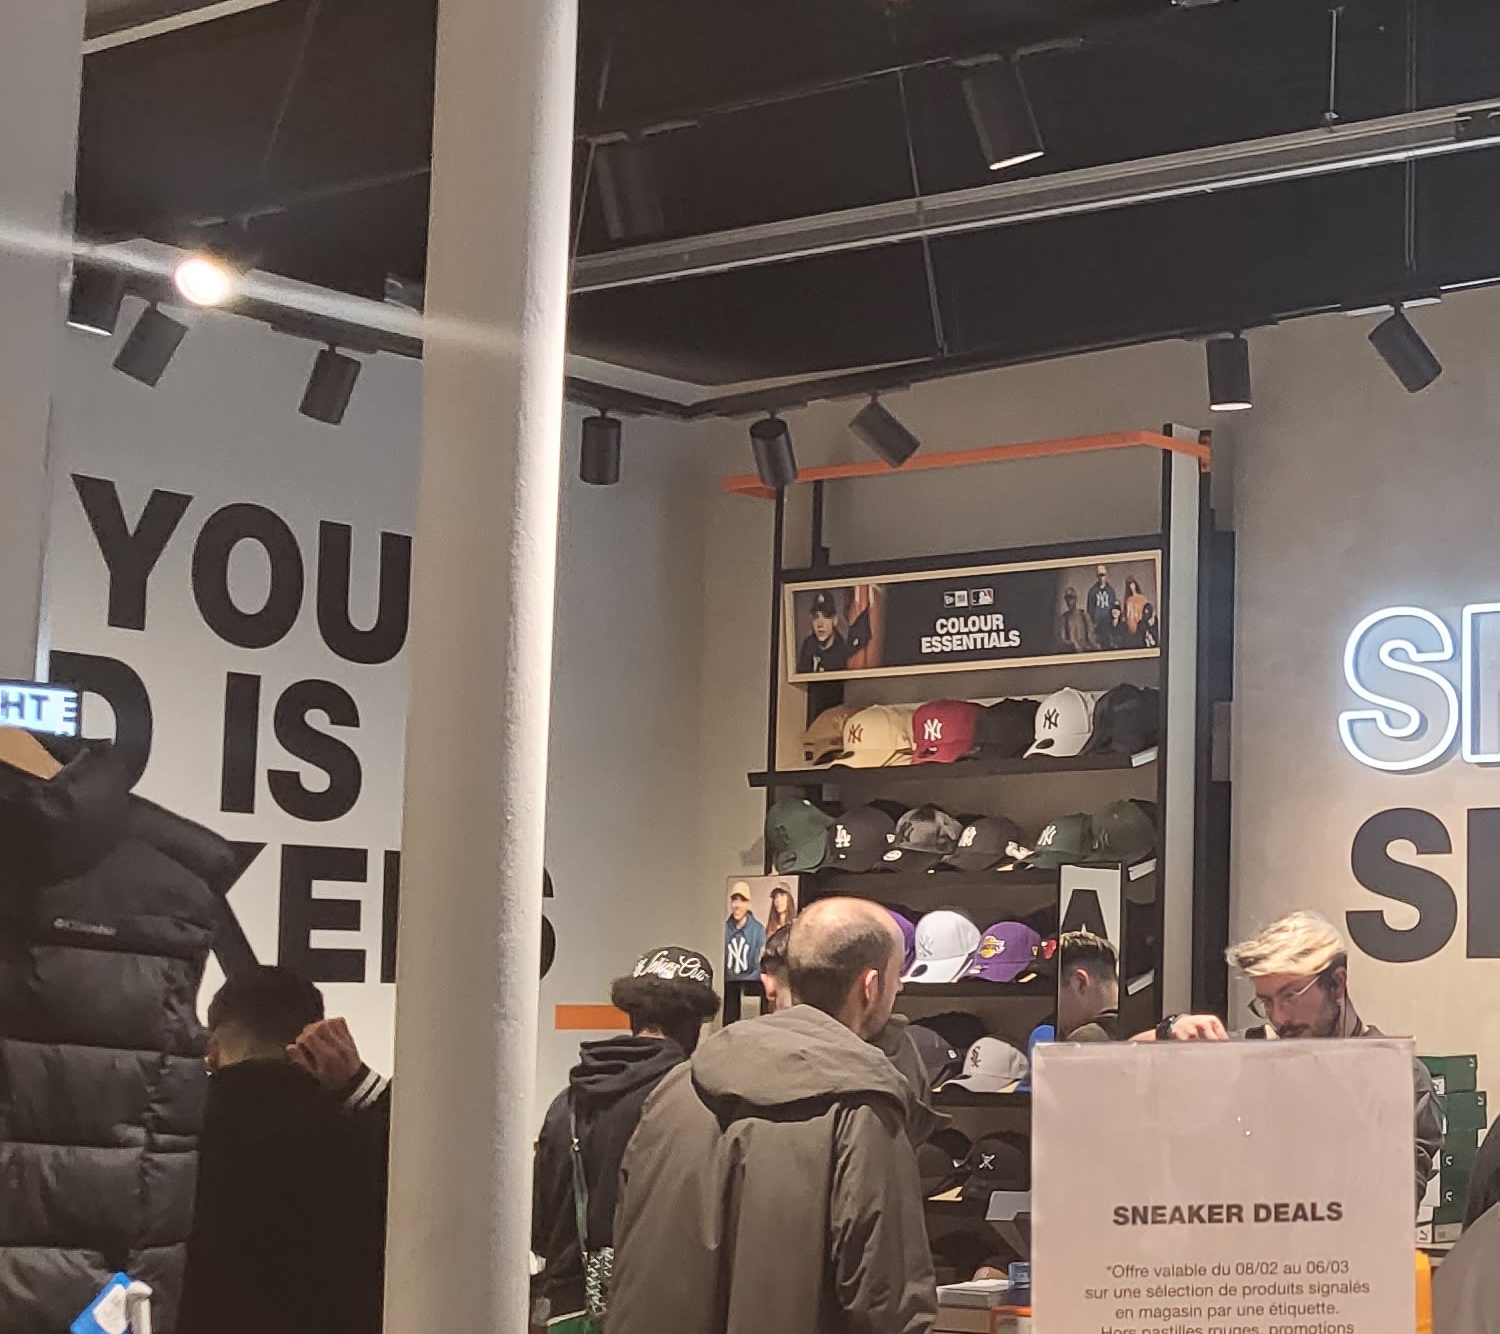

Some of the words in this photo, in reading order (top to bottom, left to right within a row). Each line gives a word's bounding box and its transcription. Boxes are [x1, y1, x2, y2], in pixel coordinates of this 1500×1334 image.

[71, 472, 413, 665] YOU
[935, 614, 1004, 635] COLOUR
[921, 630, 1021, 654] ESSENTIALS
[923, 718, 943, 742] NY
[220, 670, 363, 823] IS
[727, 936, 750, 974] NY
[1113, 1203, 1244, 1225] SNEAKER
[1253, 1201, 1343, 1223] DEALS
[1153, 1262, 1207, 1278] valable
[1211, 1261, 1231, 1276] du
[1235, 1261, 1278, 1276] 08/02
[1283, 1264, 1301, 1275] au
[1306, 1259, 1349, 1275] 06/03
[1085, 1287, 1109, 1300] sur
[1114, 1287, 1141, 1299] une
[1145, 1283, 1214, 1298] sélection
[1218, 1282, 1238, 1297] de
[1242, 1281, 1304, 1299] produits
[1308, 1279, 1370, 1297] signalés
[1115, 1308, 1133, 1320] en
[1138, 1304, 1202, 1321] magasin
[1207, 1305, 1232, 1320] par
[1236, 1304, 1265, 1317] une
[1269, 1301, 1340, 1319] étiquette.
